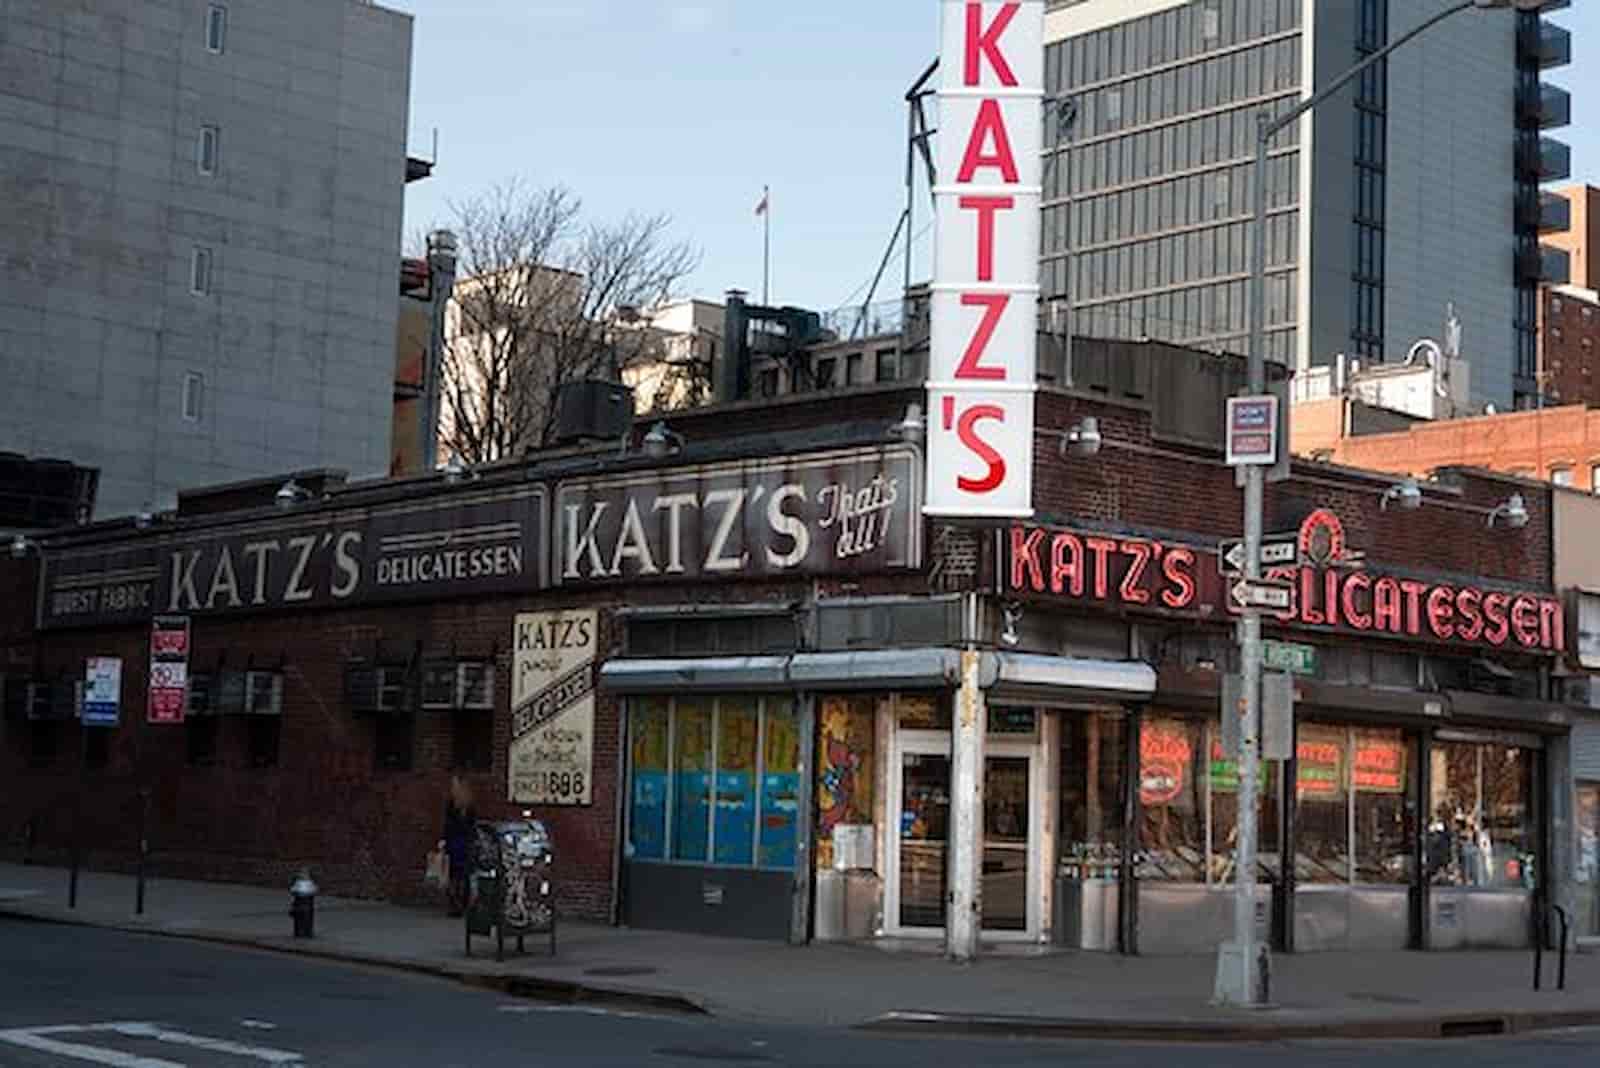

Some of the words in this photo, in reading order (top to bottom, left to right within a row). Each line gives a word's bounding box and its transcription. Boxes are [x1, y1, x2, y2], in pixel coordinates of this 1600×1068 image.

[942, 2, 1021, 493] KATZ'S
[563, 484, 811, 579] KATZ'S
[817, 475, 898, 527] That's
[167, 530, 363, 612] KATZ'S
[377, 544, 523, 585] DELICATESSEN
[1010, 524, 1196, 608] KATZ'S
[519, 617, 591, 649] KATZ'S
